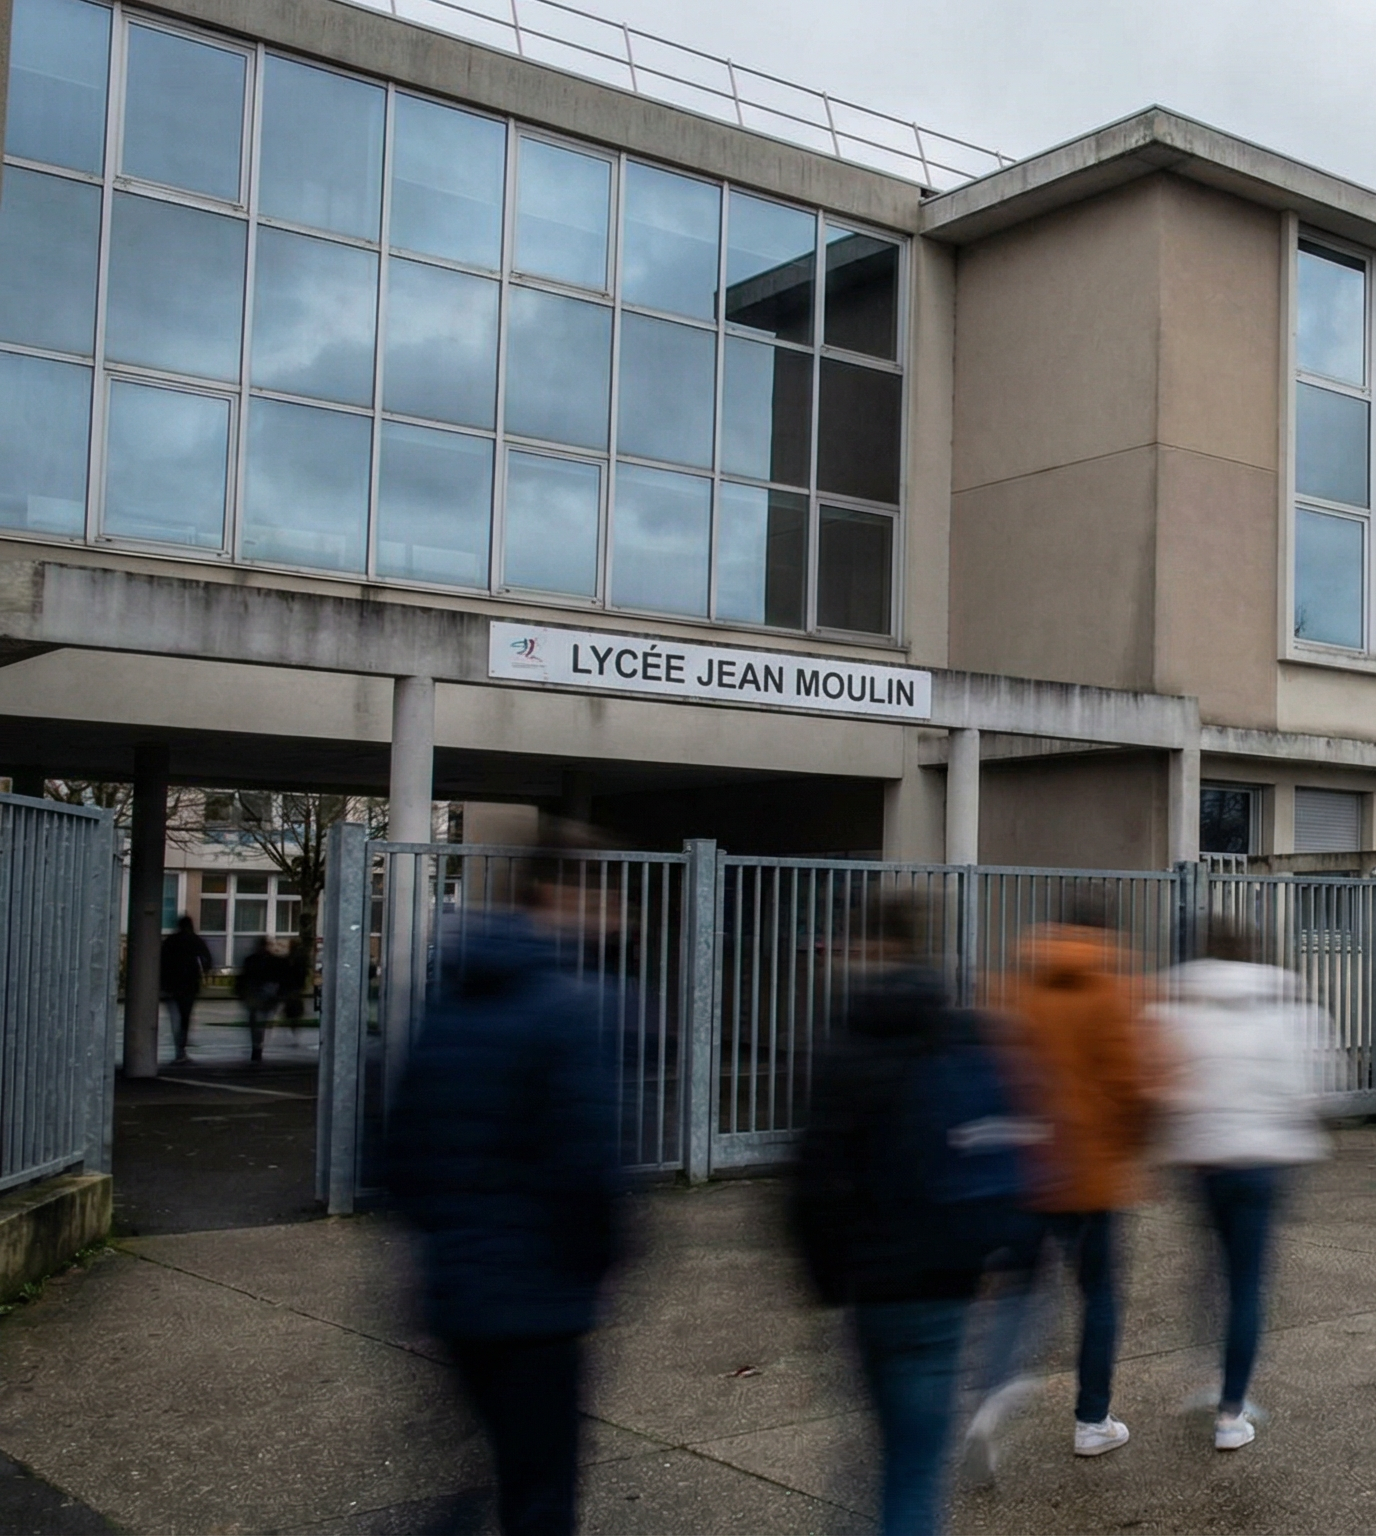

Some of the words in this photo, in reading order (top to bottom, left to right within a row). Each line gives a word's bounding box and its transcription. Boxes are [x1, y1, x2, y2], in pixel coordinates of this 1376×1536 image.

[572, 643, 686, 684] LYCÉE
[697, 658, 784, 694] JEAN
[796, 668, 915, 707] MOULIN
